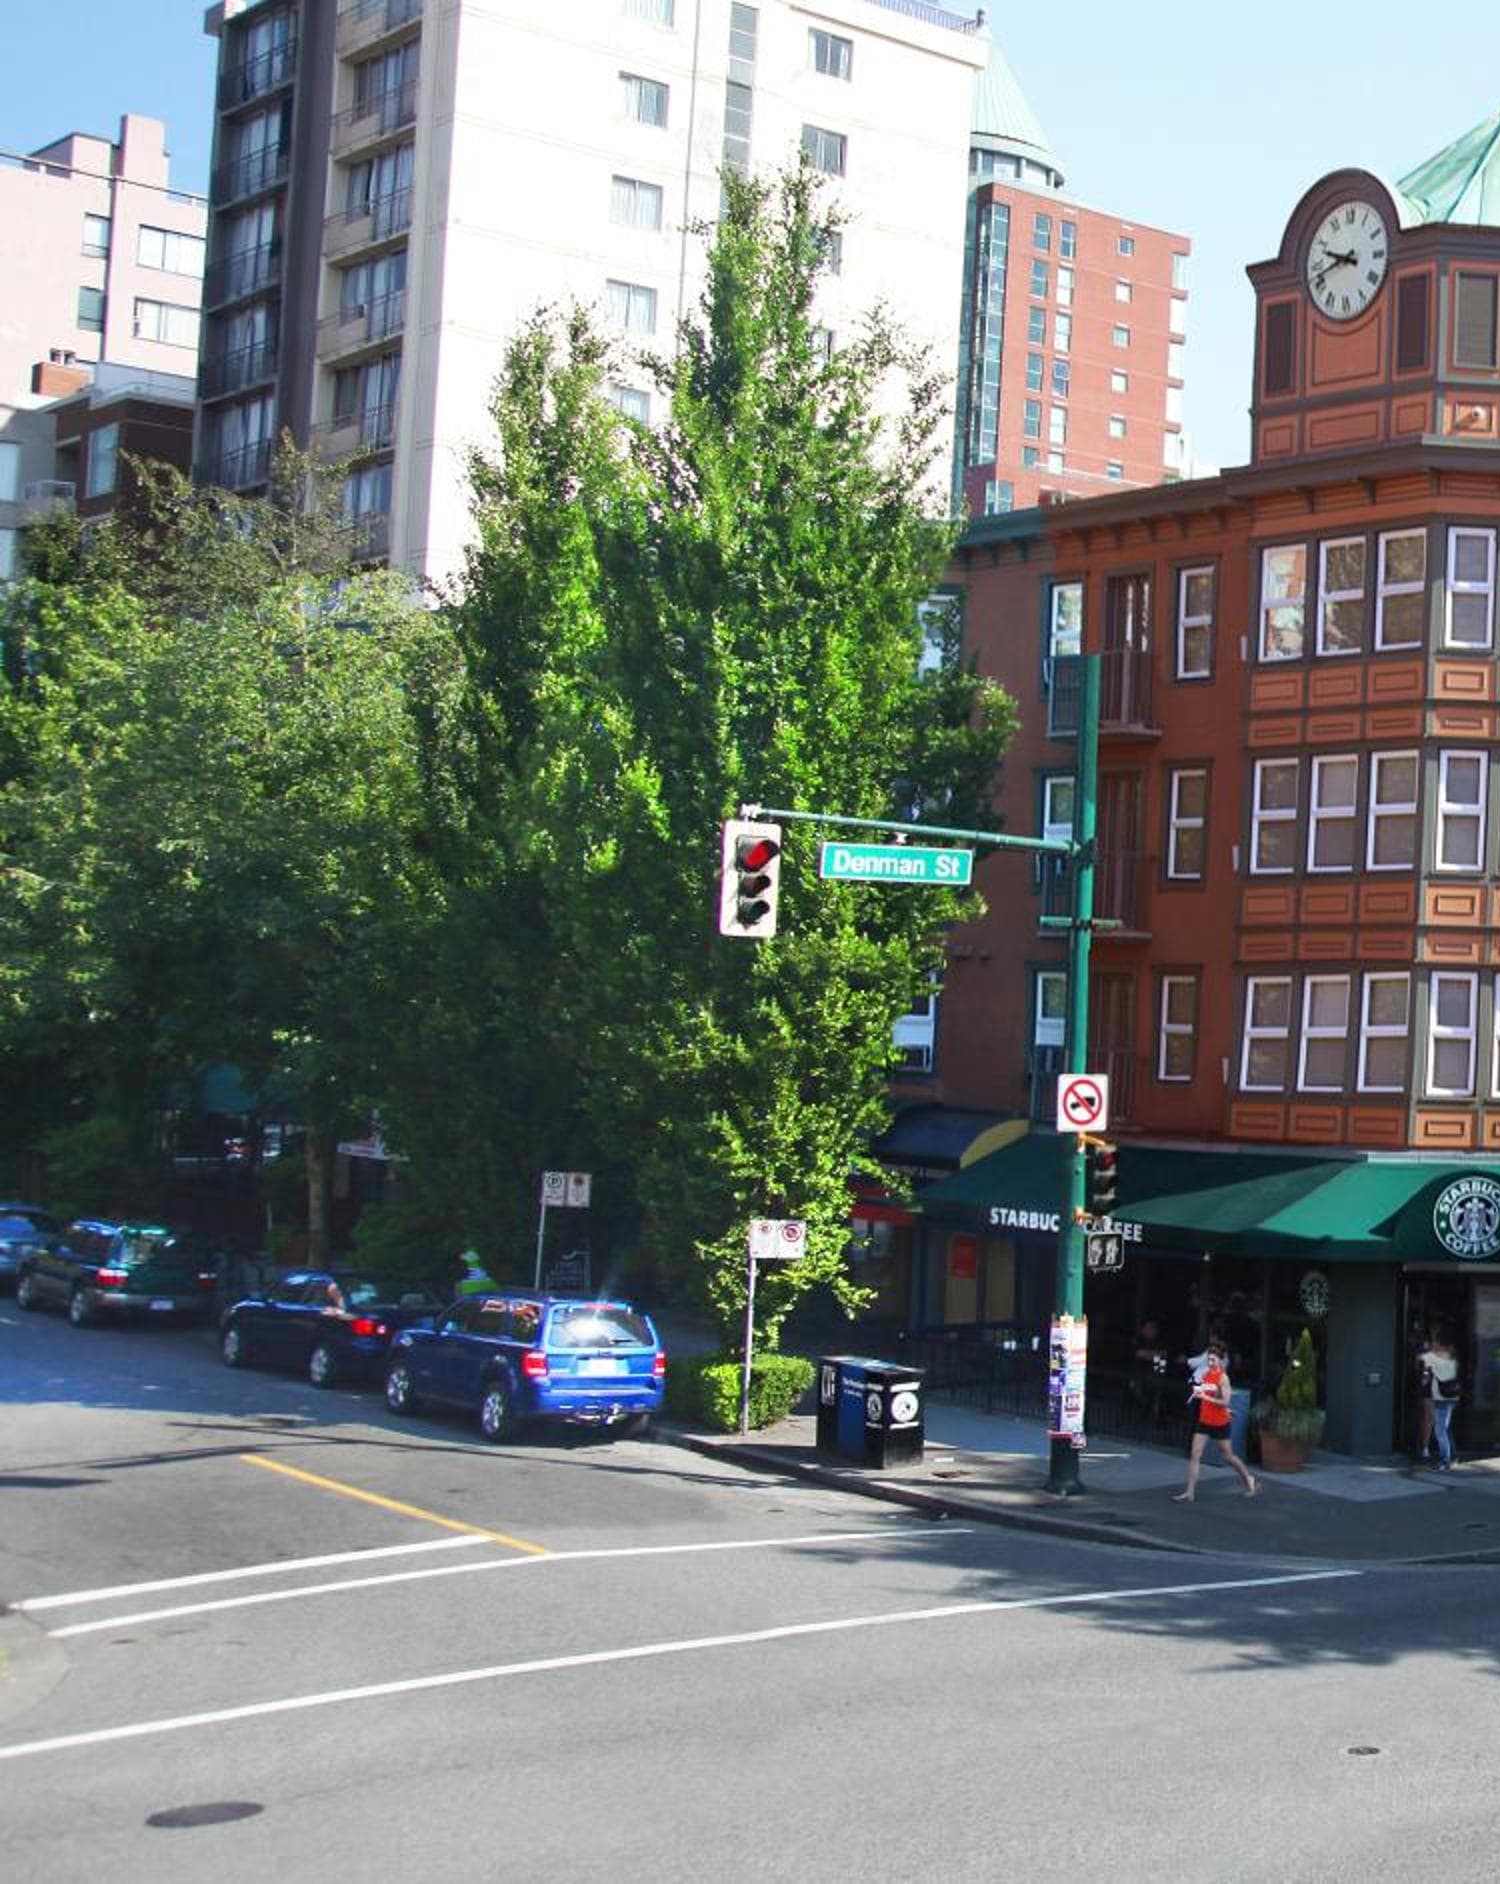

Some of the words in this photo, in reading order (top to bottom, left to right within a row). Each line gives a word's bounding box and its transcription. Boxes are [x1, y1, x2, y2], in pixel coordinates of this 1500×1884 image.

[832, 849, 925, 876] Denman
[934, 855, 960, 877] St
[989, 1207, 1060, 1233] STARBUC
[1445, 1233, 1499, 1255] COFFEE
